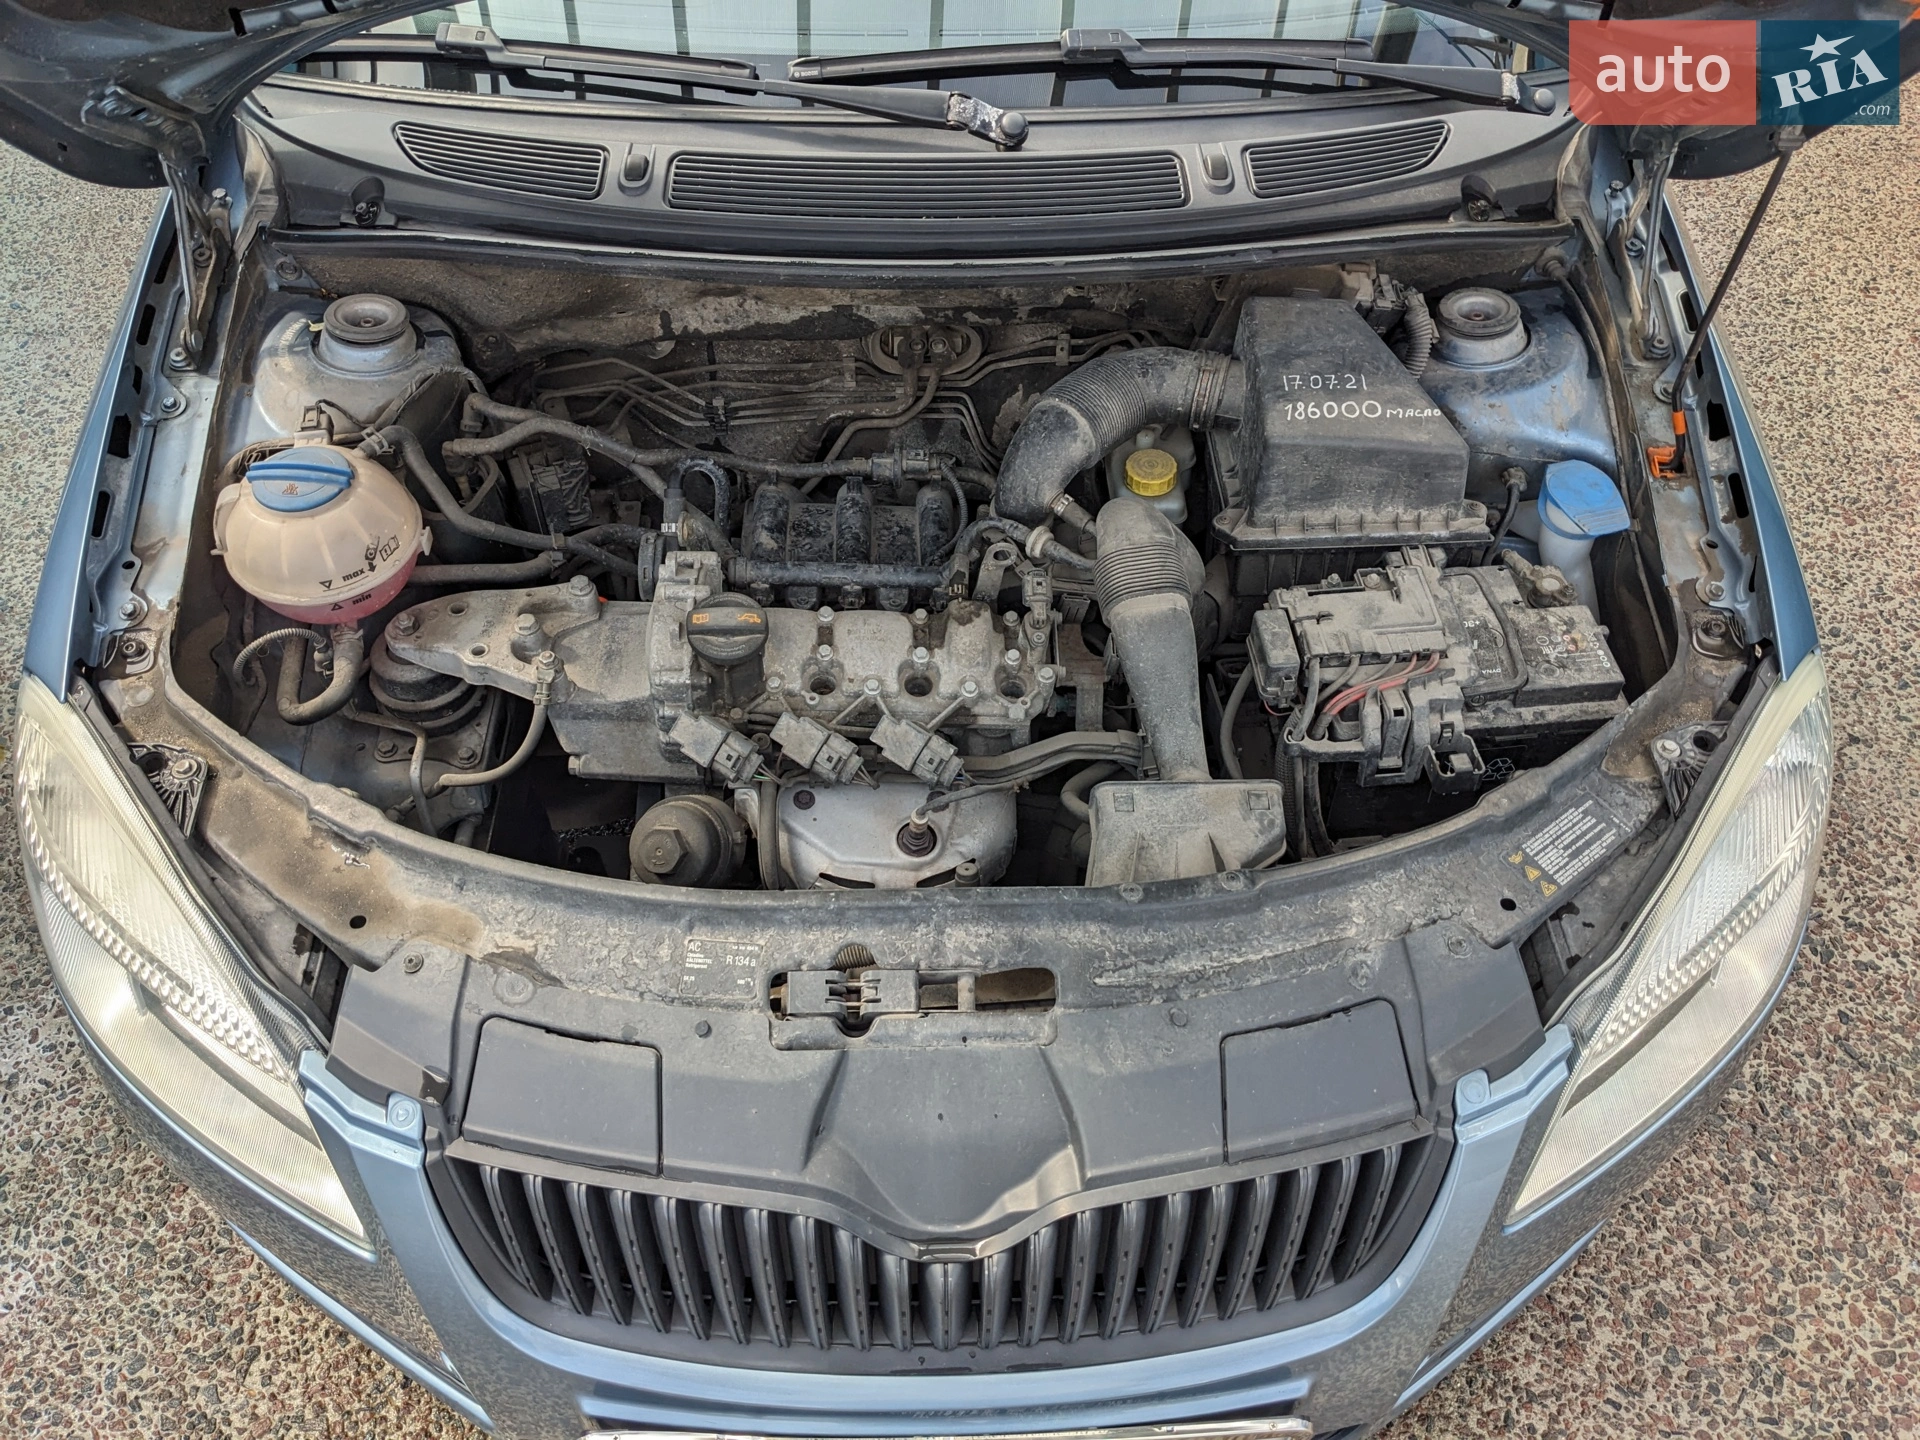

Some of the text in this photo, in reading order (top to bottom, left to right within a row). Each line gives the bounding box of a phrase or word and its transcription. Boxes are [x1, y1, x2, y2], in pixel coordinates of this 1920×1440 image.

[1283, 373, 1368, 391] 17.07.21
[1284, 400, 1382, 421] 186000
[342, 568, 366, 582] max
[352, 593, 372, 605] min
[688, 942, 701, 951] AC
